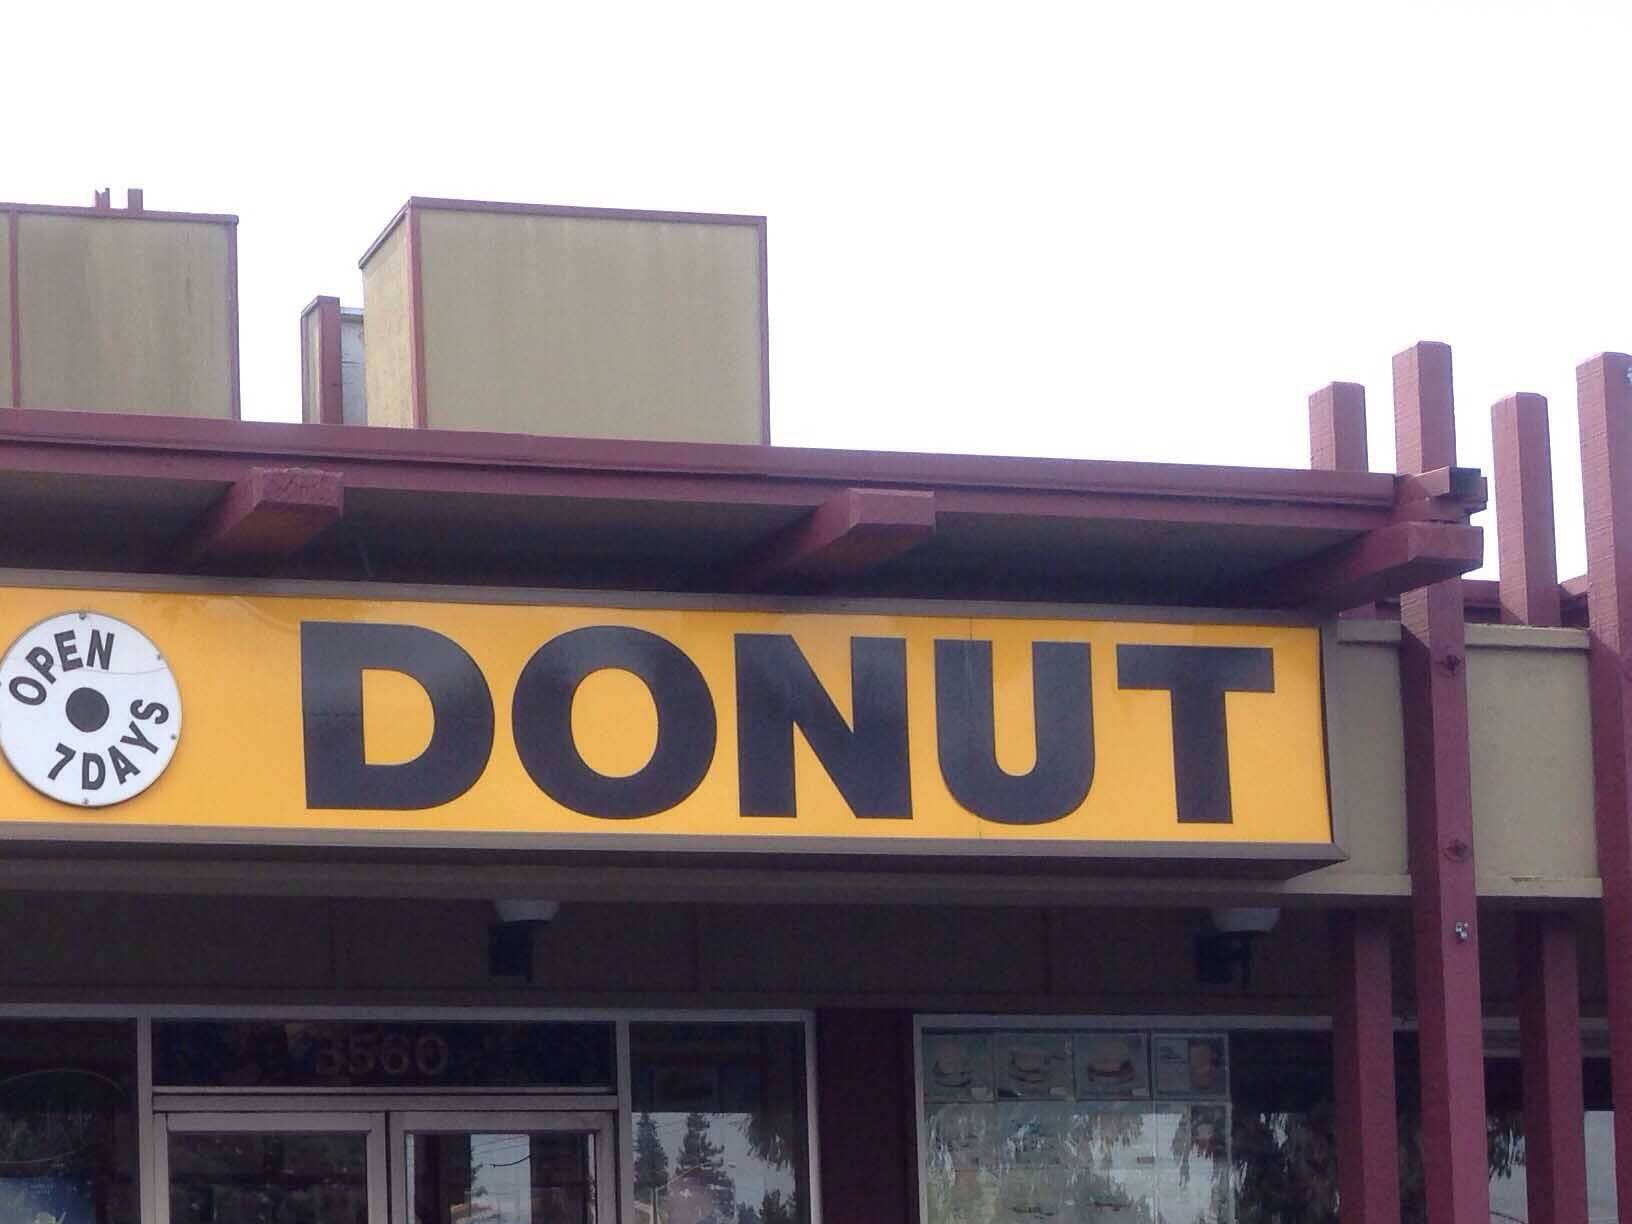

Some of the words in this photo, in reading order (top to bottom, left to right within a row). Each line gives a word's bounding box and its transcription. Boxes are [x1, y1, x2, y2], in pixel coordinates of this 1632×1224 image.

[8, 628, 116, 707] OPEN
[80, 698, 170, 791] DAYS
[299, 619, 1276, 826] DONUT
